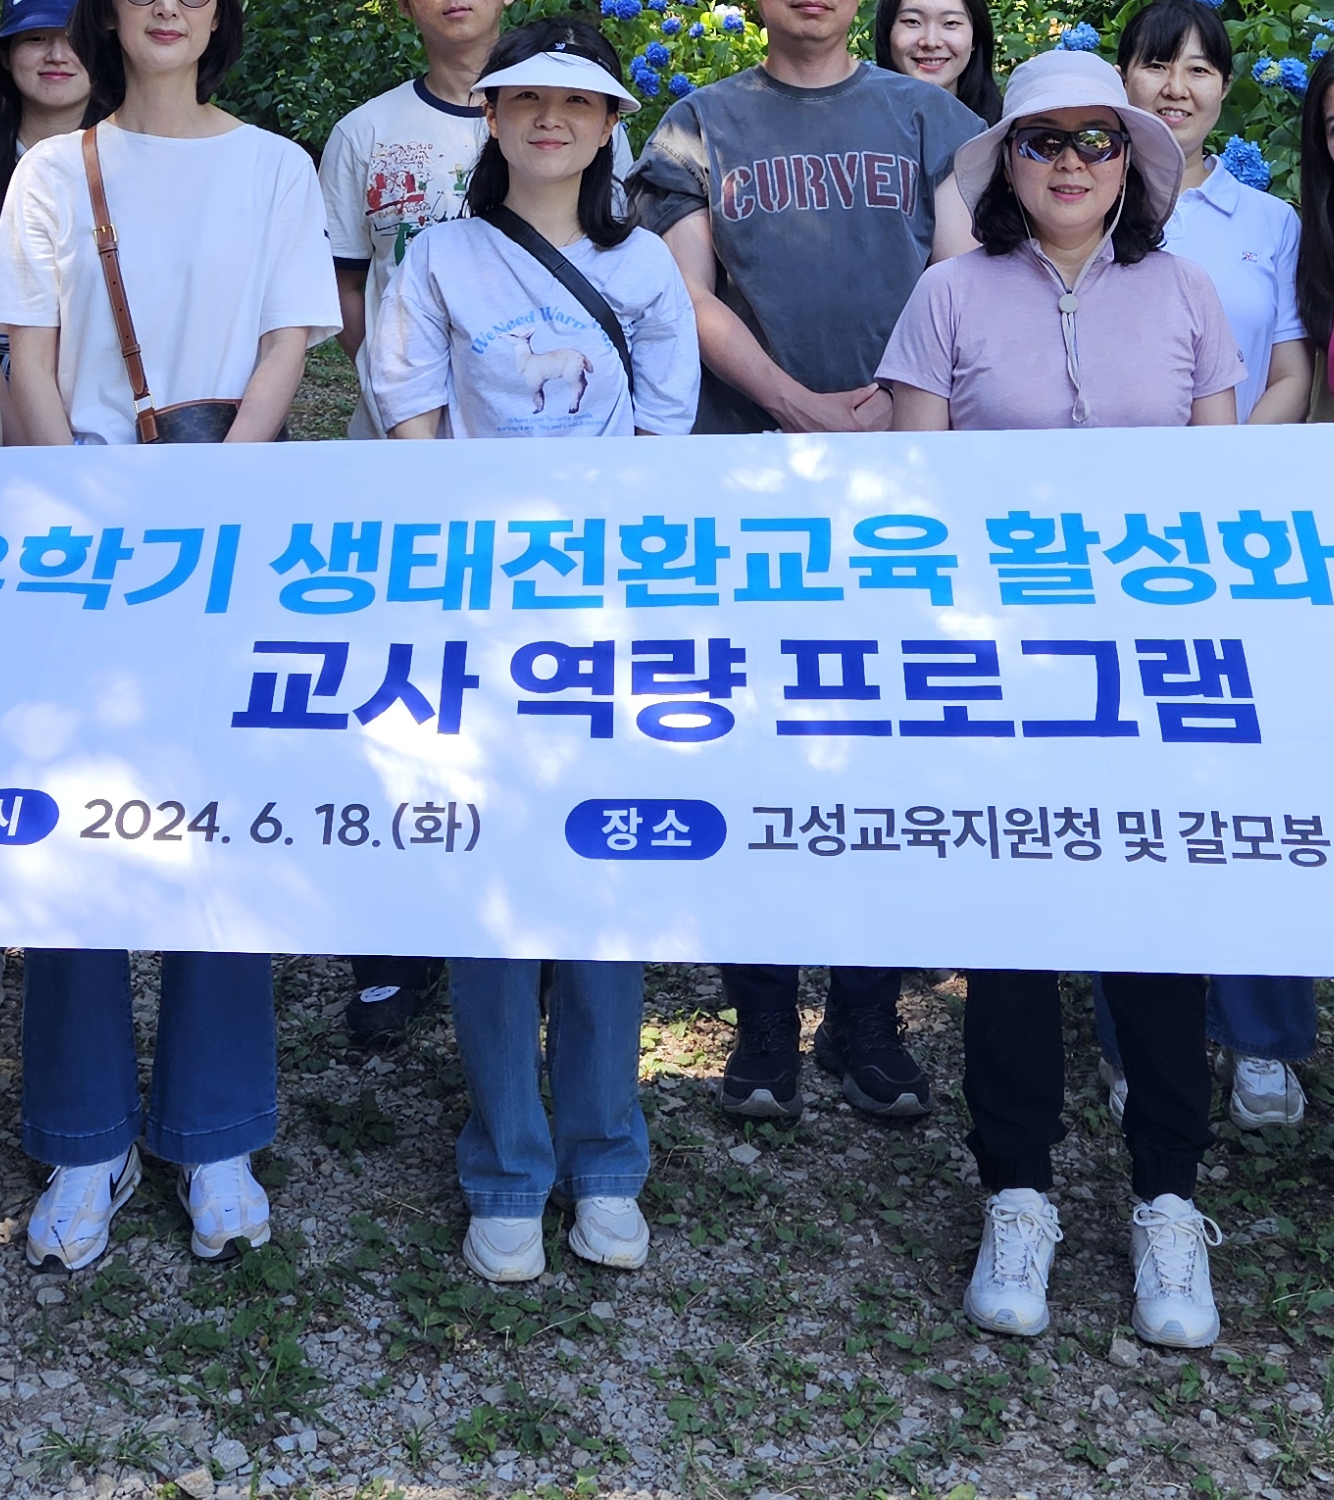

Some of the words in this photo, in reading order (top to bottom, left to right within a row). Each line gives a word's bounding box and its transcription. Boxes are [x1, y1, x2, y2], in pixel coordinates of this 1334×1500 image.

[492, 310, 536, 335] Need
[269, 514, 959, 616] 생태전환교육
[229, 640, 480, 735] 교사
[509, 637, 748, 743] 역량
[775, 638, 1263, 745] 프로그램
[79, 798, 232, 845] 2024.
[249, 801, 294, 846] 6.
[314, 801, 482, 853] 18.(화)
[602, 807, 692, 852] 장소
[747, 803, 1102, 862] 고성교육지원청
[1116, 808, 1168, 864] 및
[1178, 810, 1332, 868] 갈모봉
